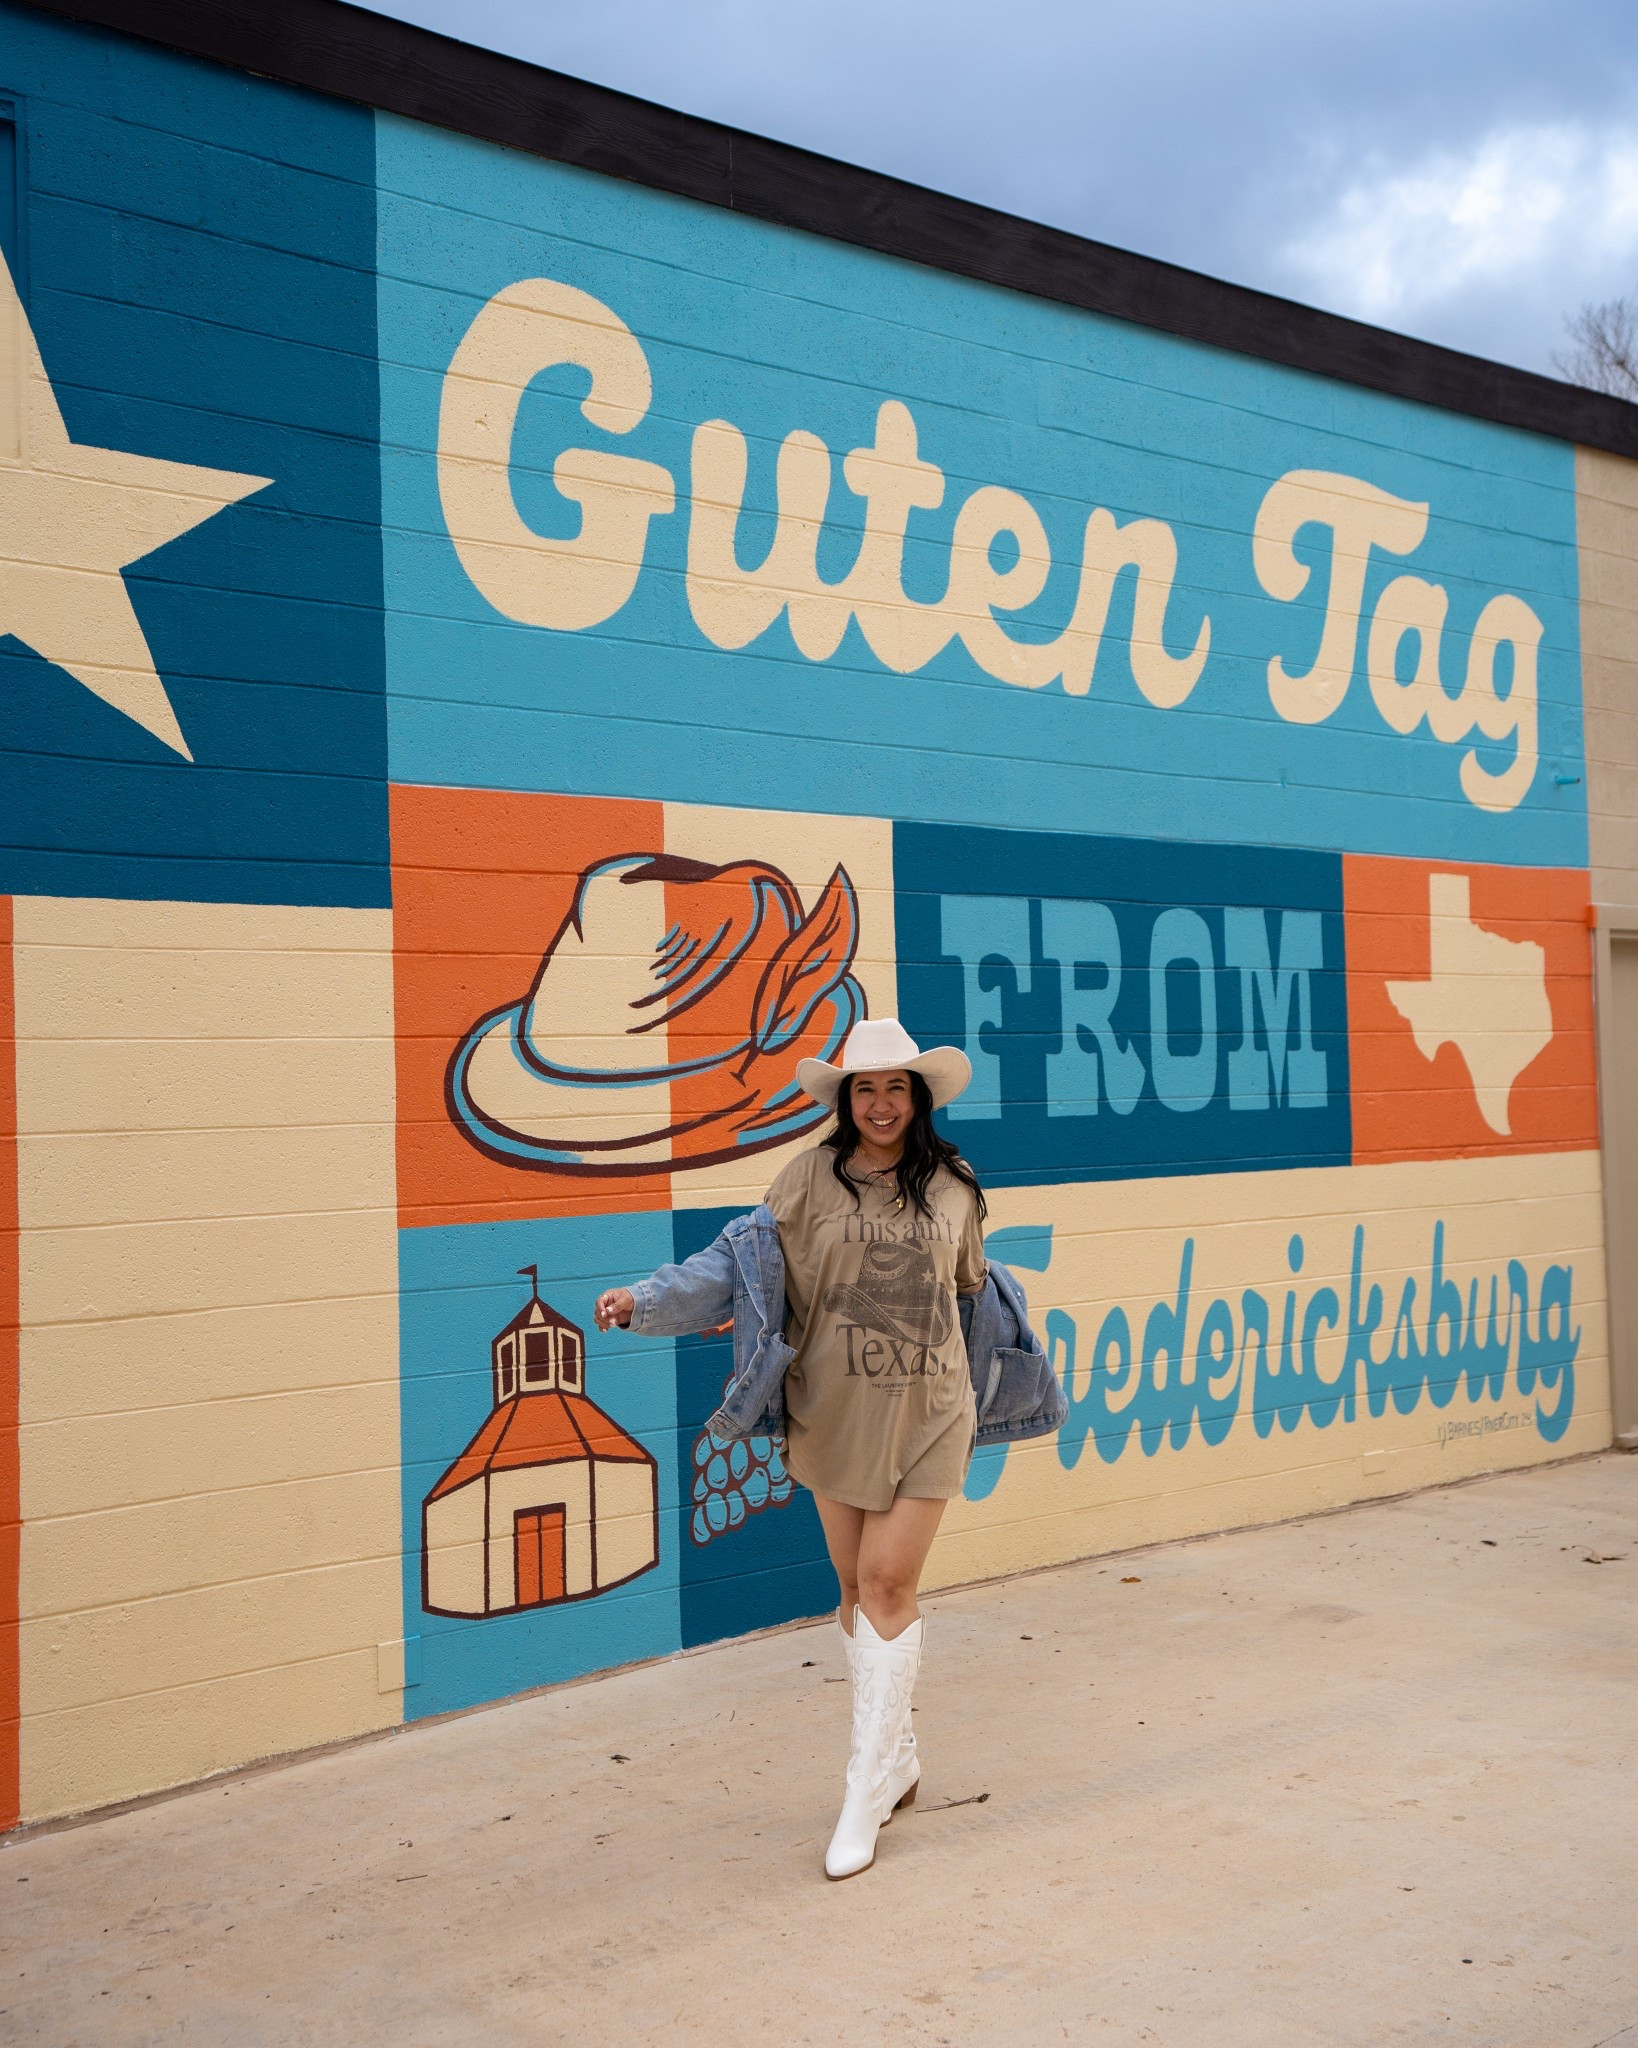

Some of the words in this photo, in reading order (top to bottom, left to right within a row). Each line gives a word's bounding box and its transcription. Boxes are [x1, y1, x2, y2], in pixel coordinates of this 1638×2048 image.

[437, 277, 1211, 709] Guten
[1252, 468, 1545, 813] Tag
[940, 895, 1329, 1121] FROM
[836, 1213, 898, 1243] This
[902, 1212, 954, 1245] ain't
[836, 1323, 948, 1378] Texas.
